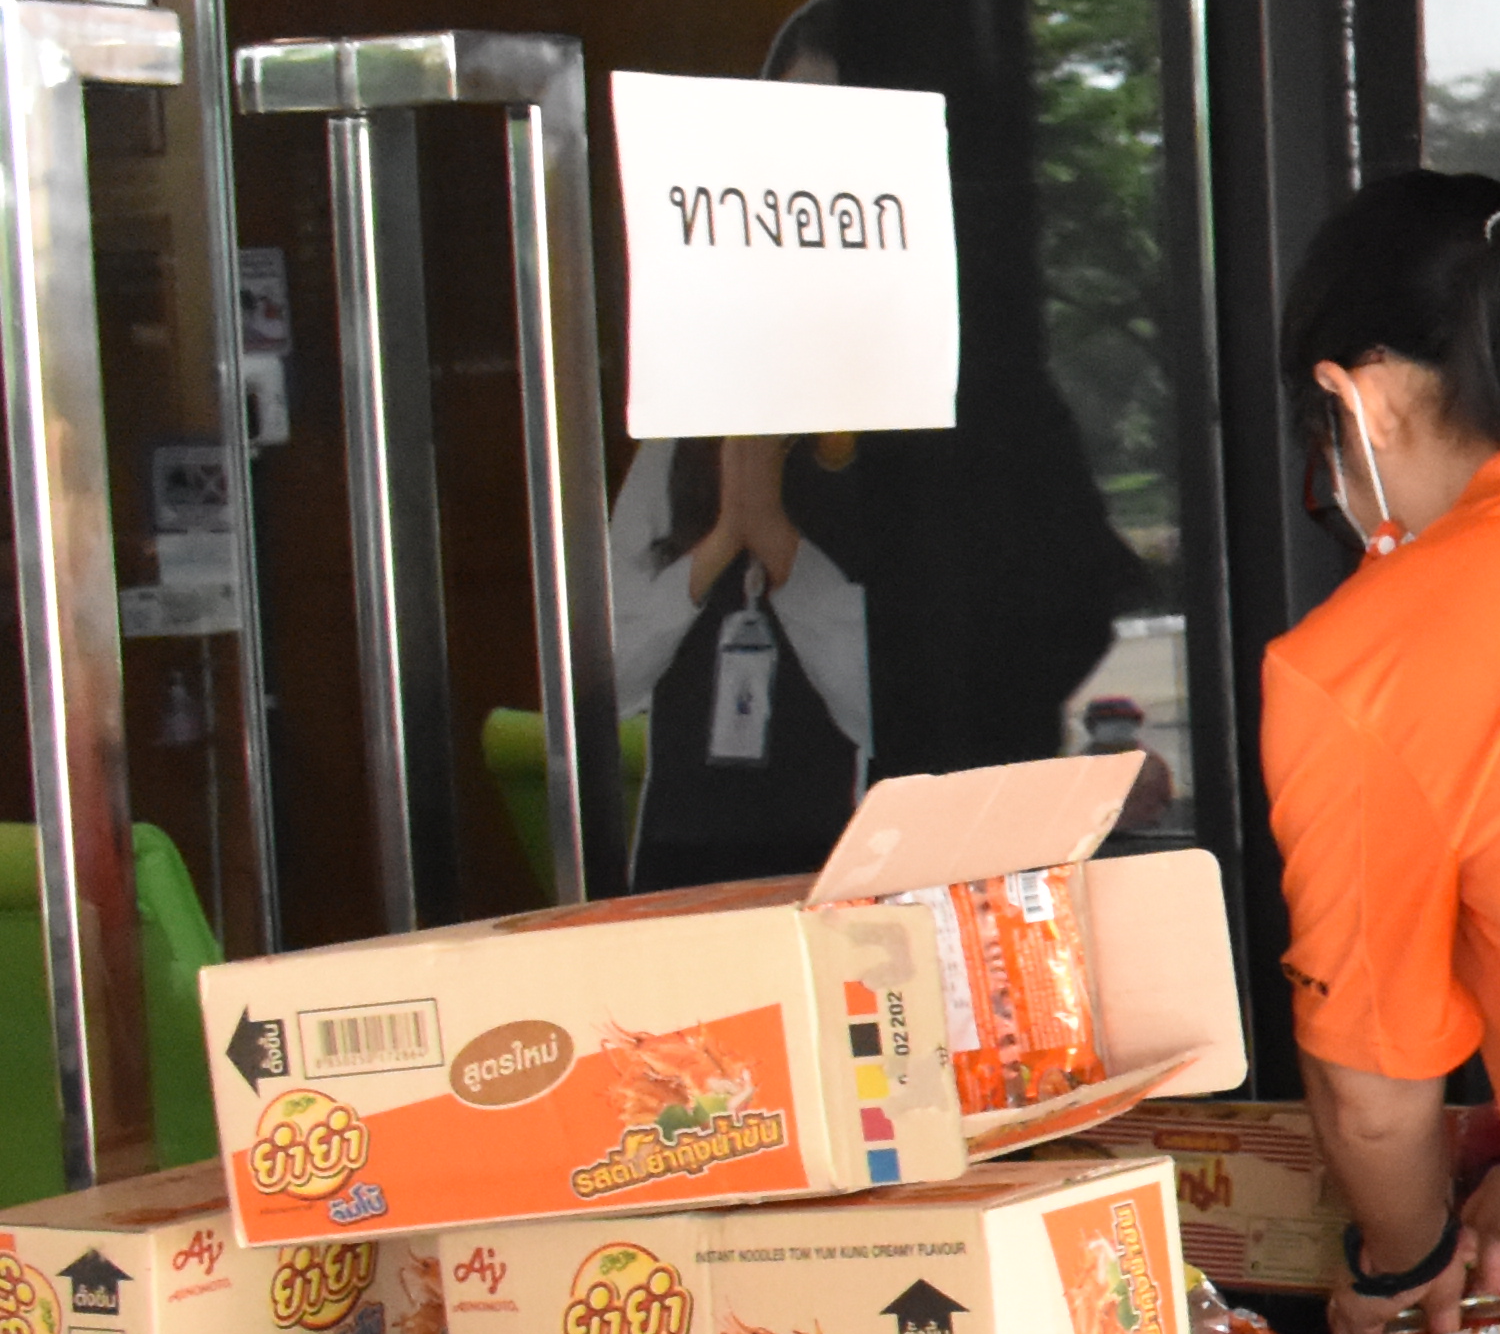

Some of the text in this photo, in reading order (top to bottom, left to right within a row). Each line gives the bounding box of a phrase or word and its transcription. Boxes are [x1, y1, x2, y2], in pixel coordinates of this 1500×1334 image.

[670, 185, 907, 250] ทางออก
[463, 1033, 559, 1093] สูตรใหม่
[251, 1105, 370, 1194] ยำยำ
[738, 1248, 786, 1262] NOODLES
[789, 1247, 811, 1260] TOM
[814, 1247, 837, 1259] YUM
[840, 1246, 869, 1259] KUNG
[873, 1244, 914, 1257] CREAMY
[918, 1242, 967, 1256] FLAVOUR
